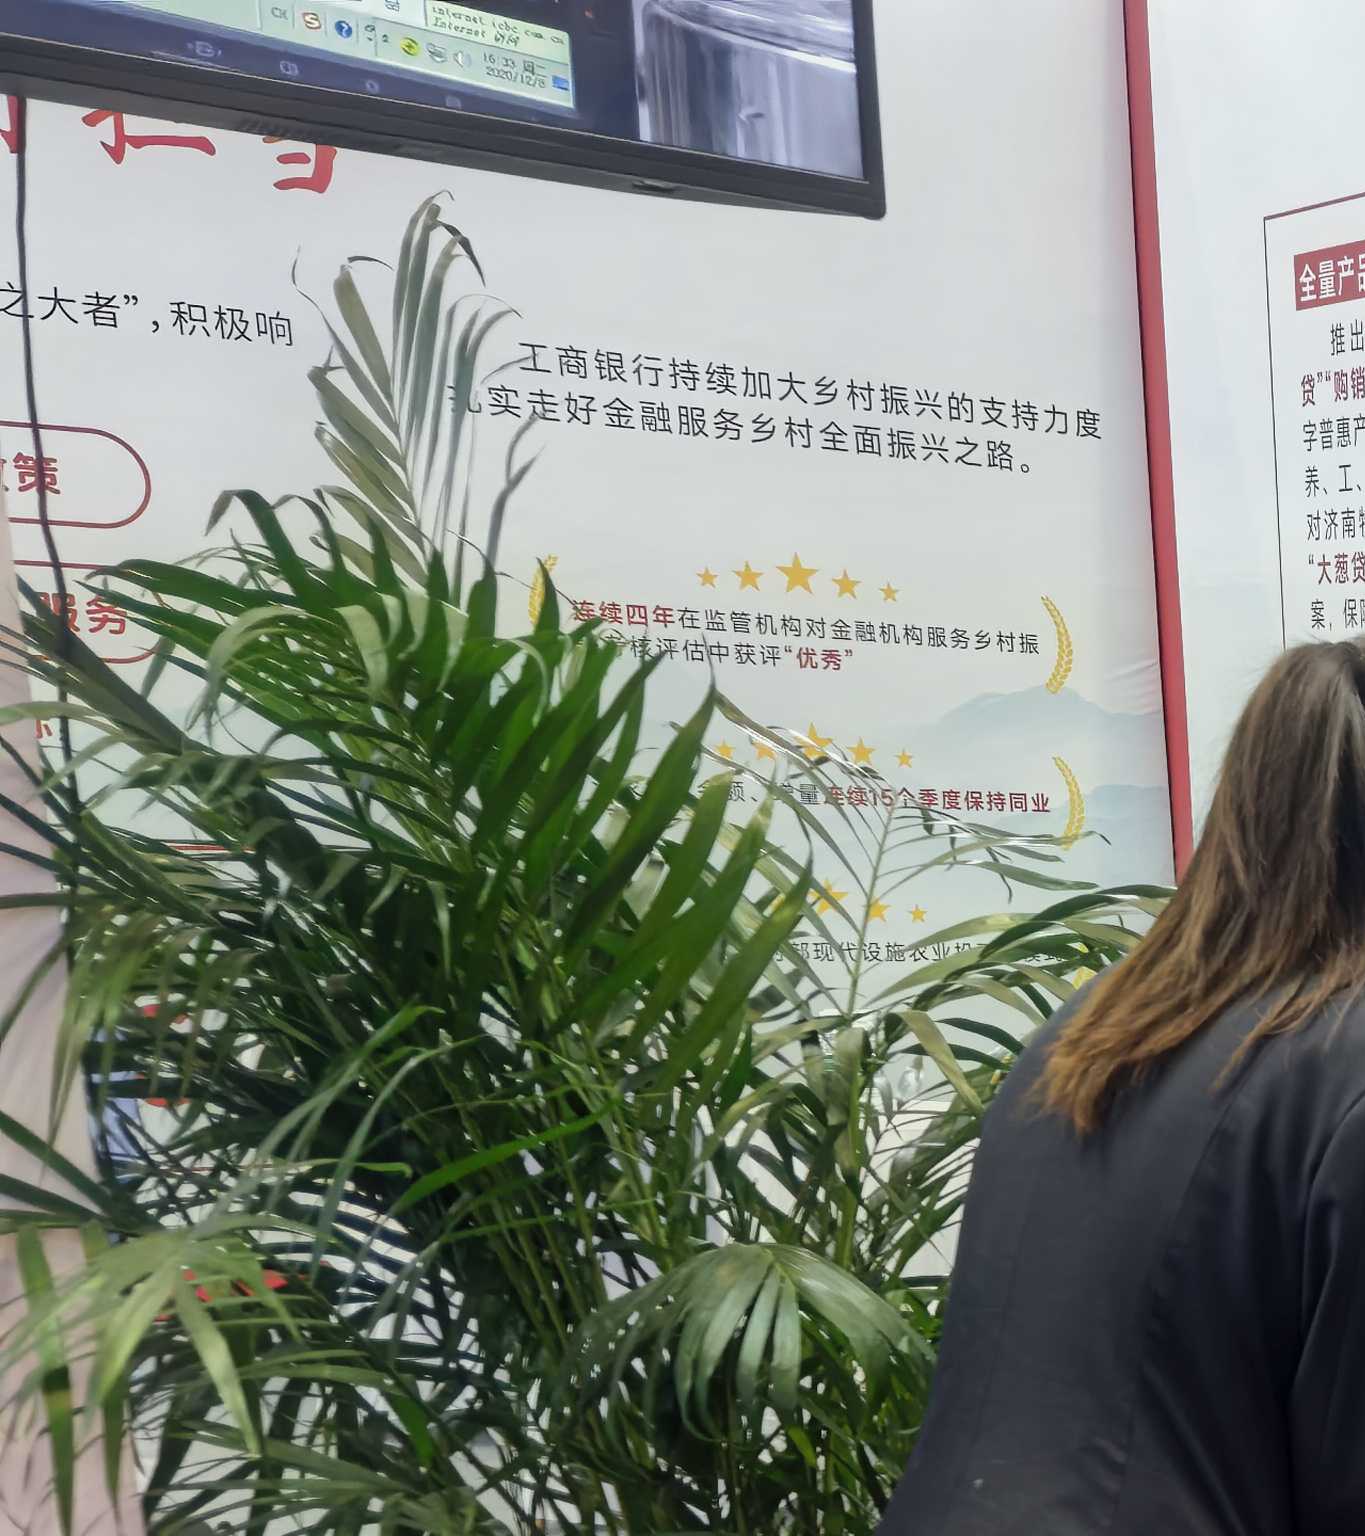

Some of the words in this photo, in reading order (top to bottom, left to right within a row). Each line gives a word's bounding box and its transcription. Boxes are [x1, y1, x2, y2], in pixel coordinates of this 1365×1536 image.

[518, 342, 1102, 441] 工商银行持续加大乡村振兴的支持力度
[572, 599, 1041, 655] 连续四年在监管机构对金融机构服务乡村振
